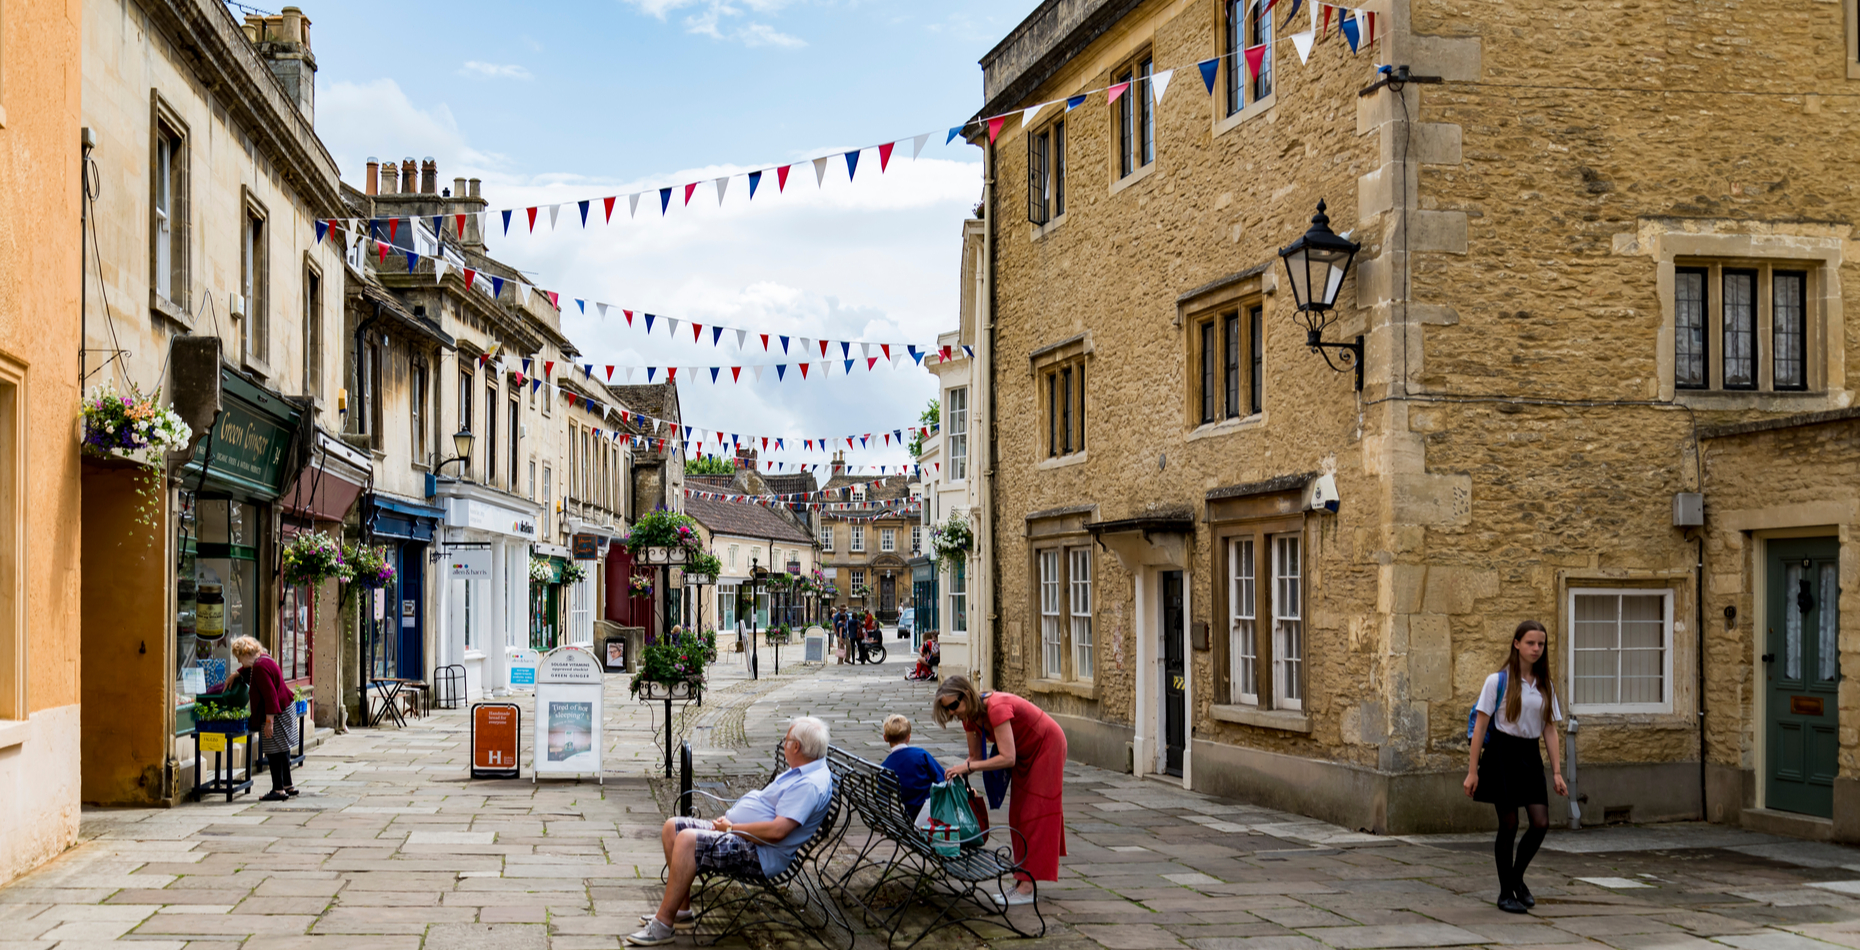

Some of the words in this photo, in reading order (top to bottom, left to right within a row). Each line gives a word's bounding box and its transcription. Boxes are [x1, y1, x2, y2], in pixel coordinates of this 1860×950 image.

[220, 411, 243, 447] Green
[244, 422, 268, 461] Ginger
[272, 446, 281, 465] 34
[1803, 559, 1810, 567] 17
[552, 703, 569, 711] Tired
[569, 703, 577, 711] of
[555, 712, 585, 720] sleeping?
[488, 750, 502, 765] H
